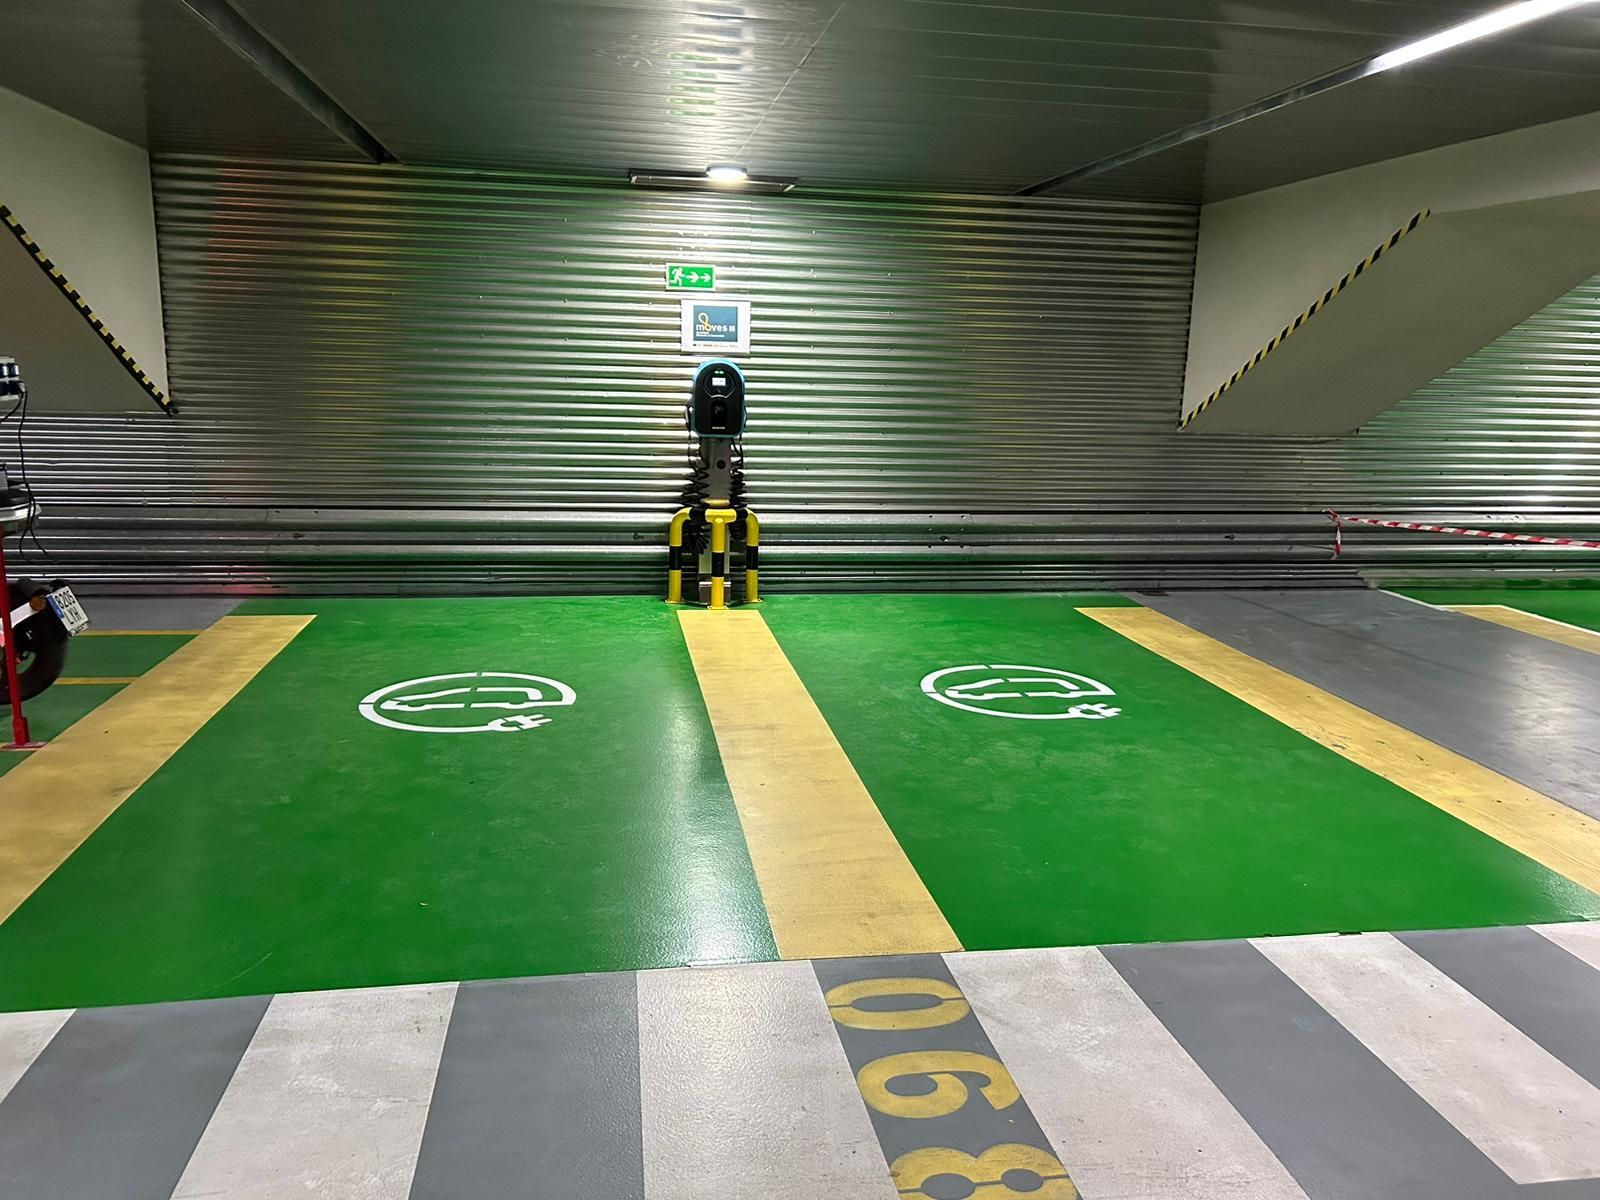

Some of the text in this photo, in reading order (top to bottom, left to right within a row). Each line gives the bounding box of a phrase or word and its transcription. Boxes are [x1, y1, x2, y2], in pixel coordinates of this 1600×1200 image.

[696, 313, 728, 332] moves
[54, 590, 76, 609] 8205
[64, 606, 82, 625] LYH
